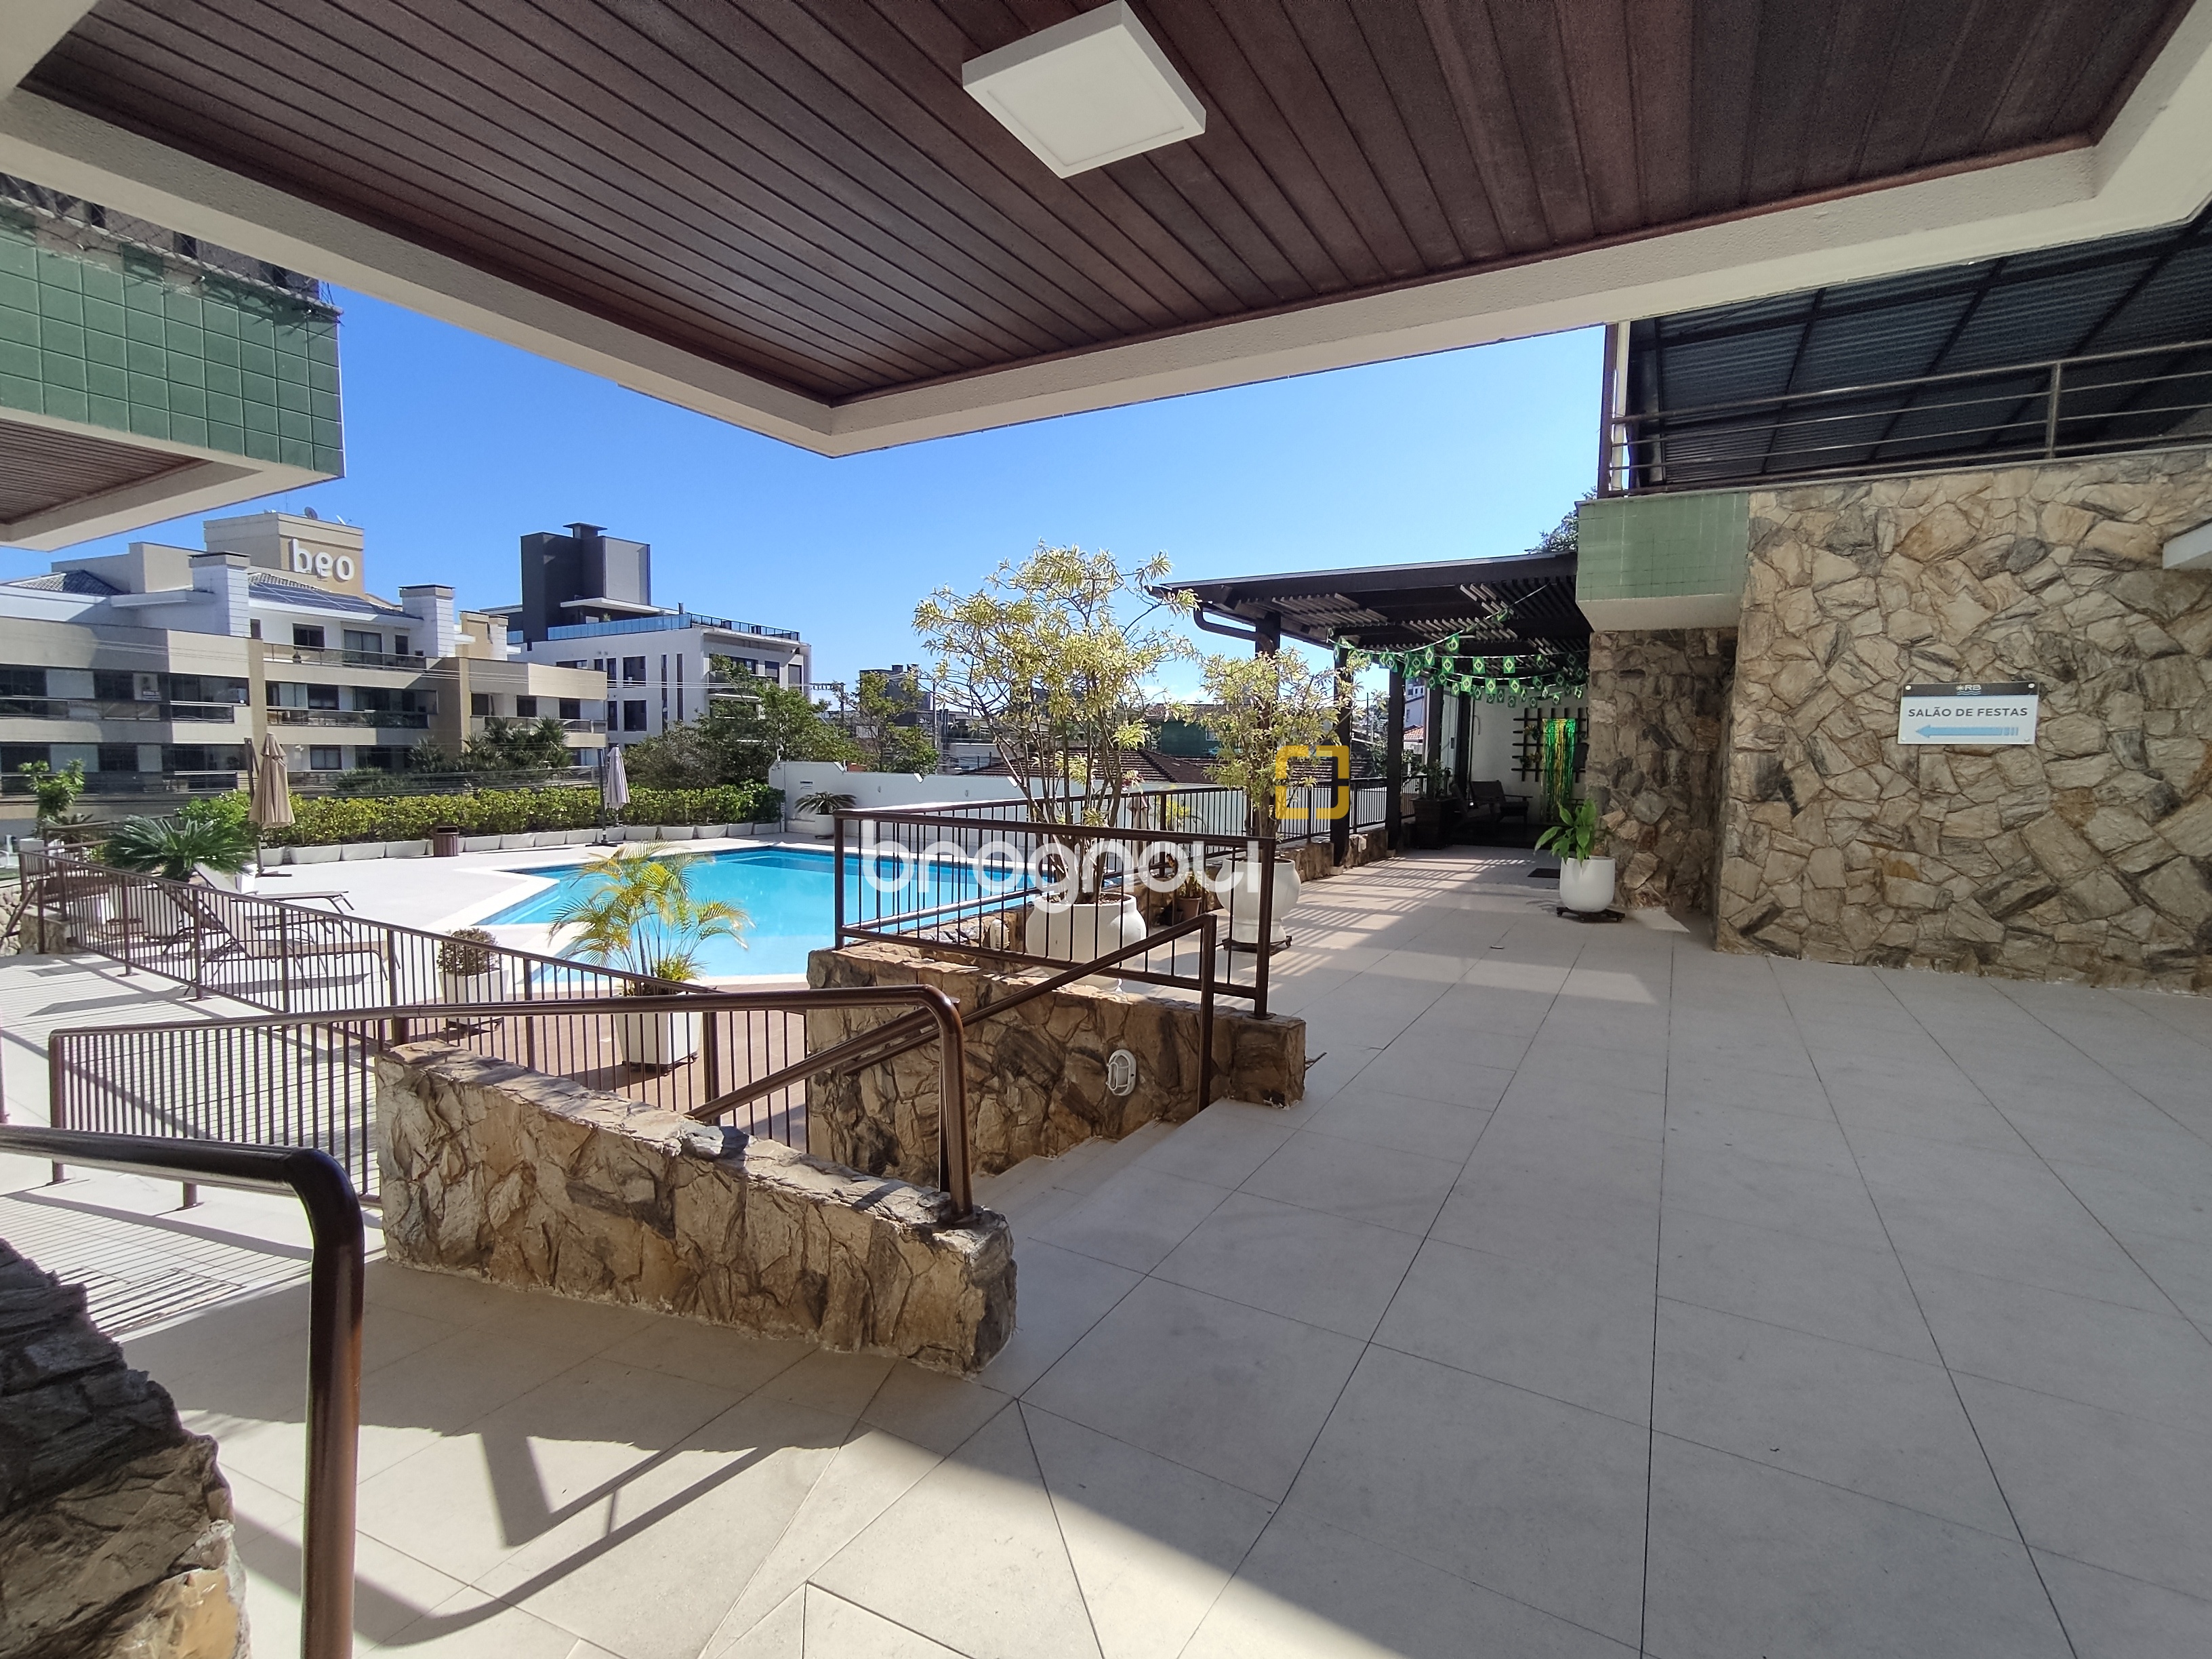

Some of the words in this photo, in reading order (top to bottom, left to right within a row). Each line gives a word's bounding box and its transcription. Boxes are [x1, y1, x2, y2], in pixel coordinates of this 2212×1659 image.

[292, 538, 355, 581] beo
[1908, 706, 1952, 717] SALÃO
[1955, 708, 1973, 717] DE
[1977, 708, 2028, 717] FESTAS
